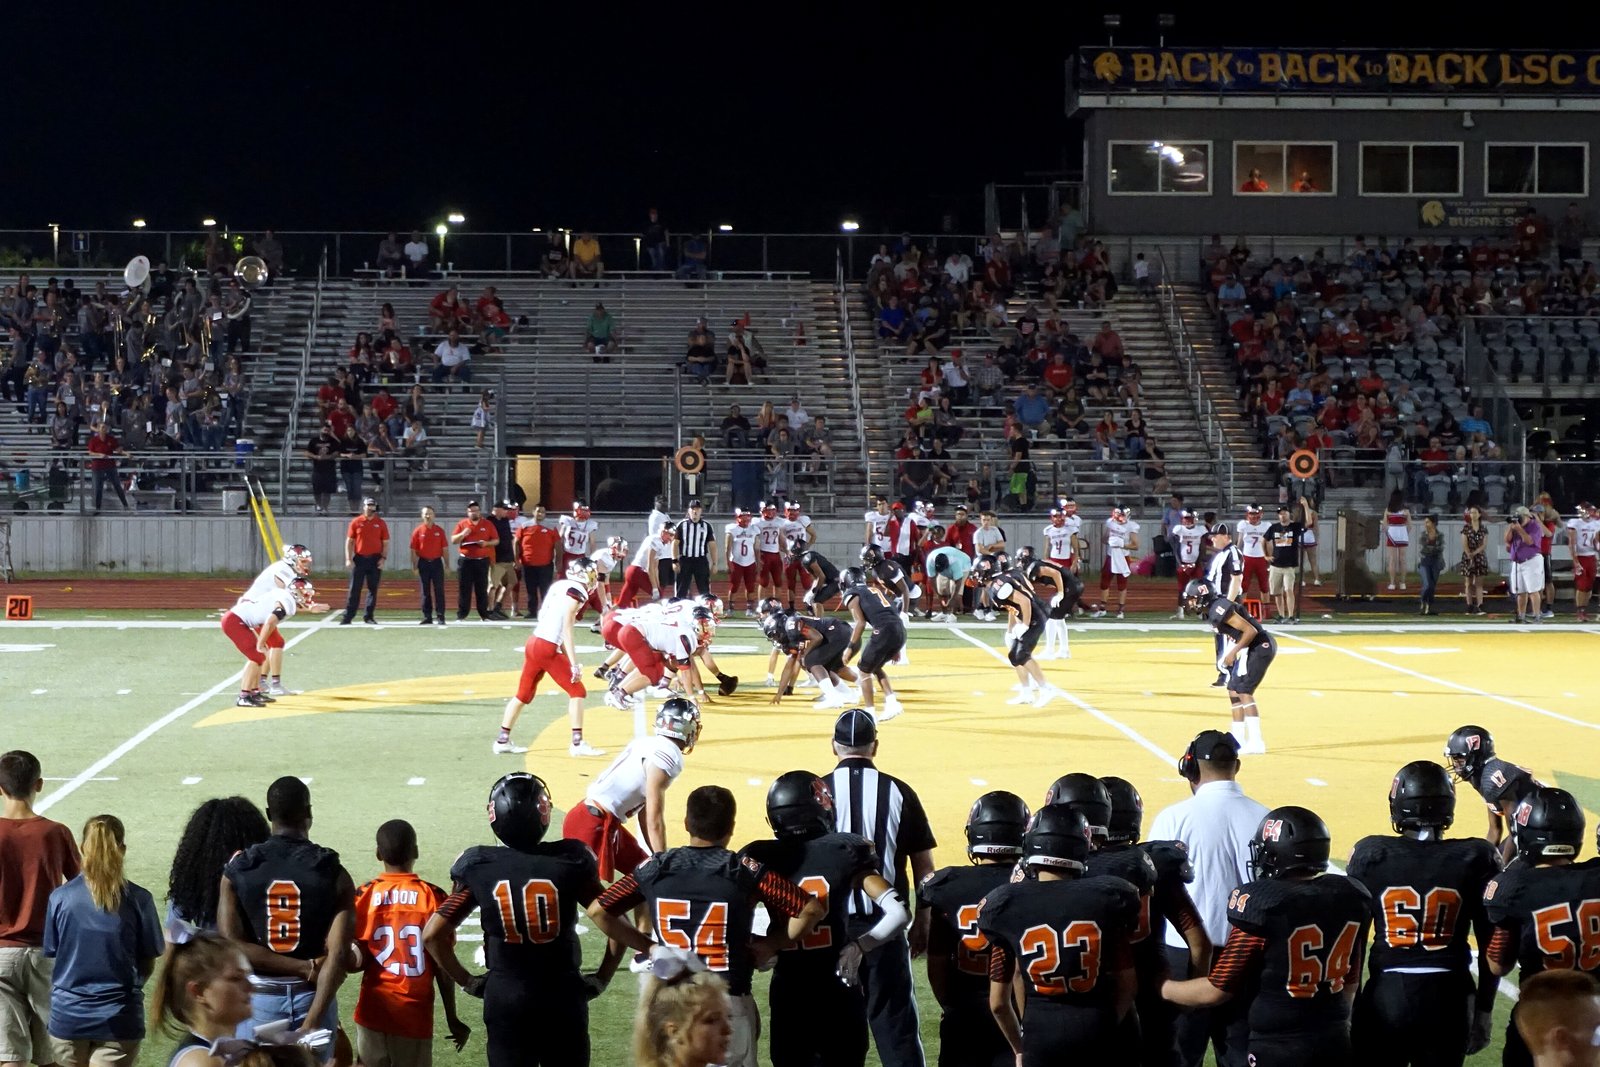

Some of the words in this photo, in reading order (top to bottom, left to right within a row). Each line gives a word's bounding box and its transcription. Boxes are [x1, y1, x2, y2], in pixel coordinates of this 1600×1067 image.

[1131, 51, 1234, 84] BACK
[1236, 60, 1254, 75] to
[1258, 52, 1362, 84] BACK
[1363, 61, 1384, 76] to
[1386, 52, 1489, 84] BACK
[1499, 53, 1577, 85] LSC
[568, 530, 587, 549] 54
[740, 539, 749, 557] 6
[1055, 540, 1063, 555] 4
[1186, 540, 1193, 555] 5
[1251, 536, 1260, 549] 7
[8, 598, 29, 617] 20
[1465, 734, 1481, 751] 17
[1490, 769, 1507, 788] 17
[1262, 819, 1283, 842] 64
[1042, 857, 1073, 867] Riddell
[492, 878, 561, 945] 10
[1228, 888, 1251, 913] 64
[266, 879, 302, 954] 8
[1380, 885, 1463, 951] 60
[656, 897, 730, 972] 54
[372, 923, 428, 978] 23
[1019, 920, 1102, 995] 23
[1286, 921, 1361, 998] 64
